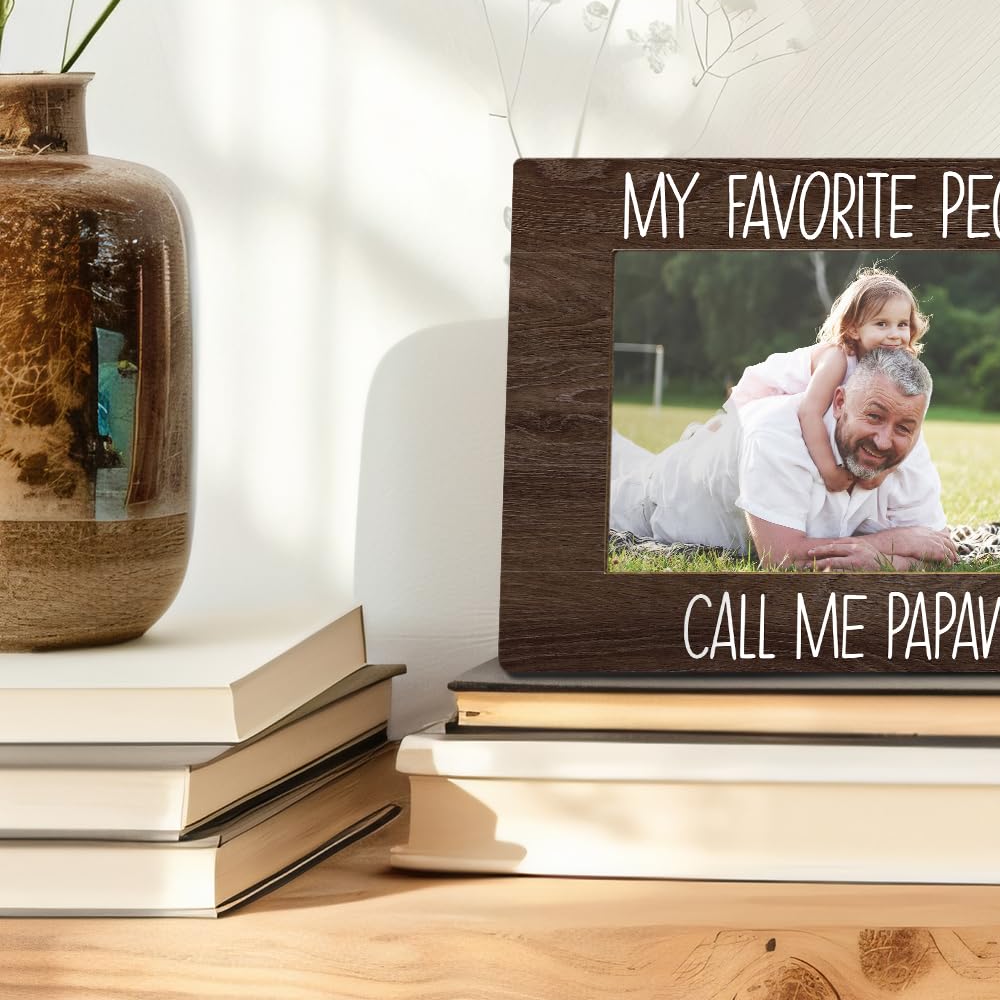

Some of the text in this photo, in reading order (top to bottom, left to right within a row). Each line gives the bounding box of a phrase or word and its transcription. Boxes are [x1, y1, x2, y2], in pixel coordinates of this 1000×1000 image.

[623, 171, 700, 240] MY
[728, 170, 917, 241] FAVORITE
[683, 591, 776, 661] CALL
[796, 591, 868, 661] ME
